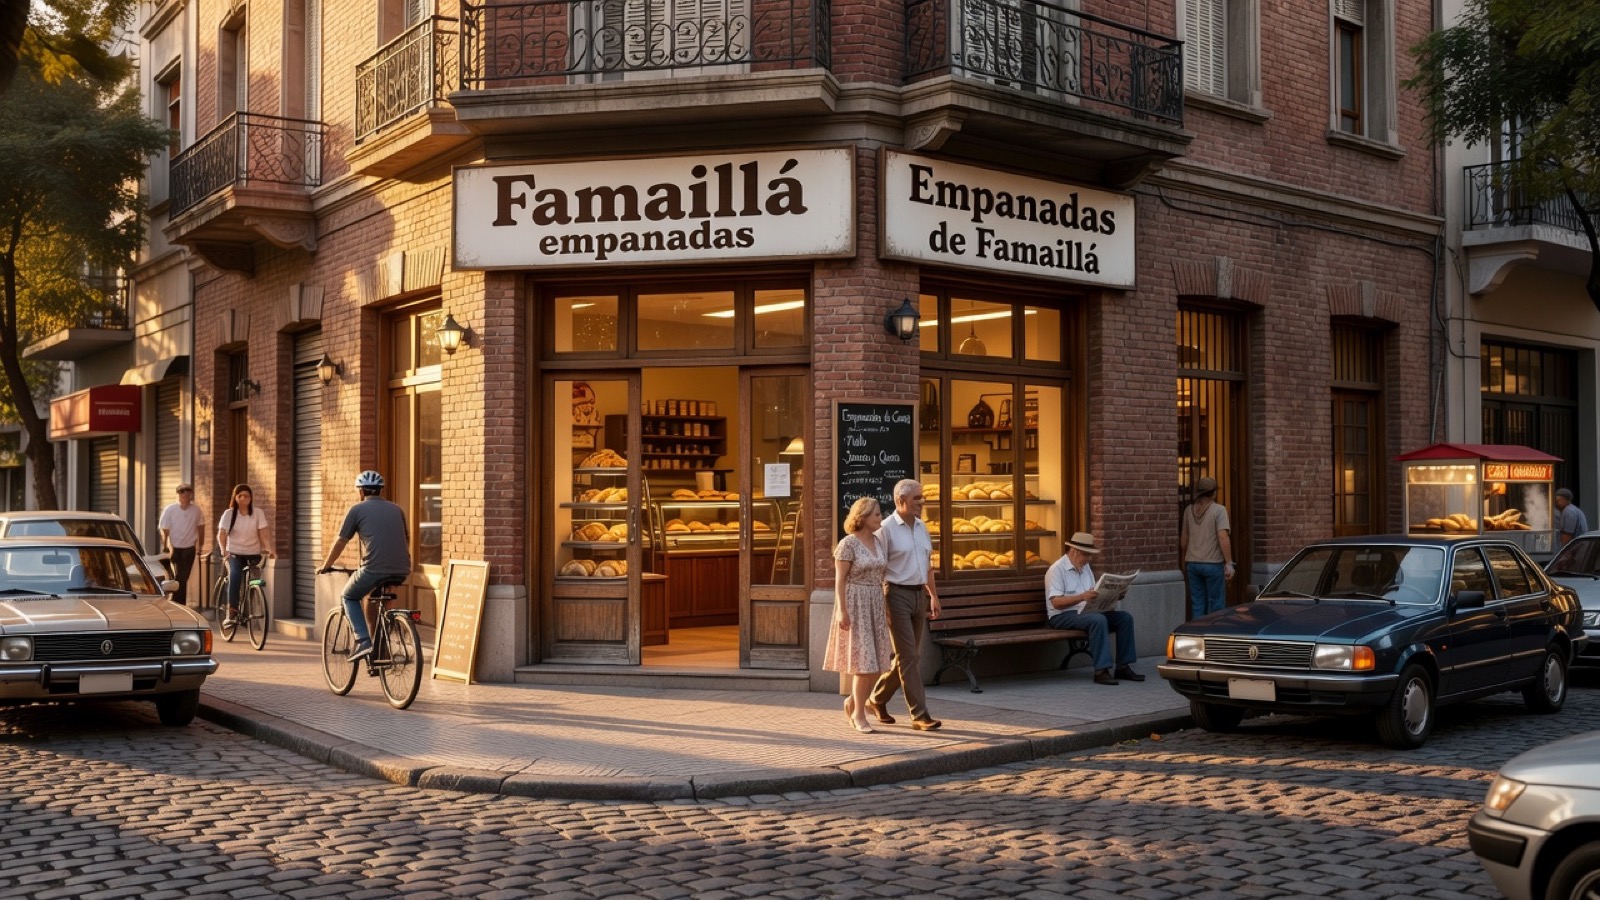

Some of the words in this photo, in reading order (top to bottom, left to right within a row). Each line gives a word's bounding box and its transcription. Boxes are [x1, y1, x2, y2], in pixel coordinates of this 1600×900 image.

[492, 158, 808, 227] Famaillá
[909, 163, 1116, 235] Empanadas
[538, 220, 755, 261] empanadas
[929, 221, 966, 255] de
[975, 226, 1100, 274] Famaillá
